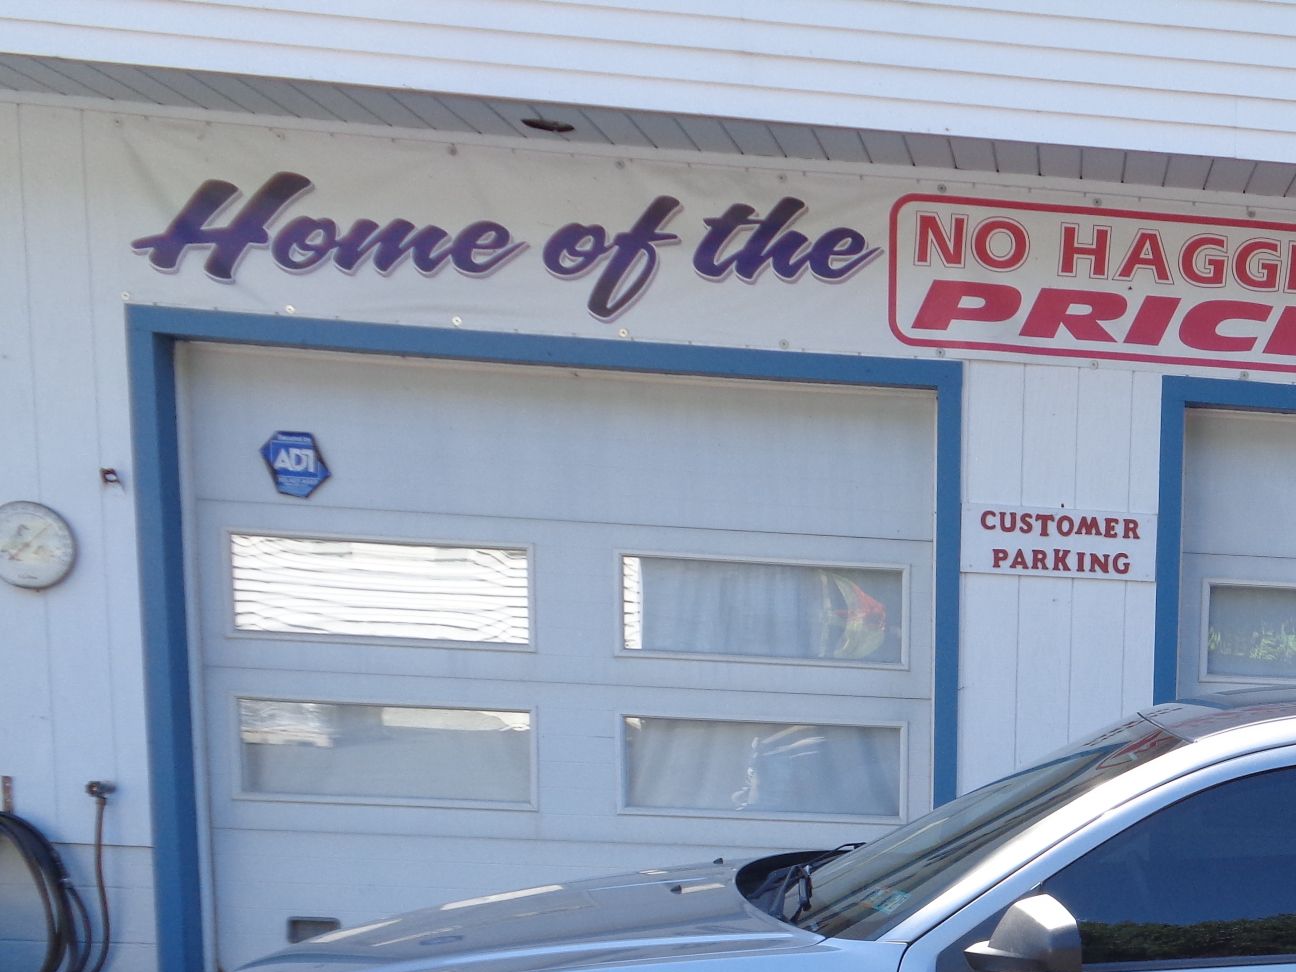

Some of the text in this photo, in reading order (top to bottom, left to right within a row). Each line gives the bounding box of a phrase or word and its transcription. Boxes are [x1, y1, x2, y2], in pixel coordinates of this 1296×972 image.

[130, 171, 884, 324] Home of the
[913, 210, 1031, 272] NO
[274, 447, 315, 473] ADT
[980, 510, 1140, 540] CUSTOMER
[992, 548, 1131, 575] PARKING
